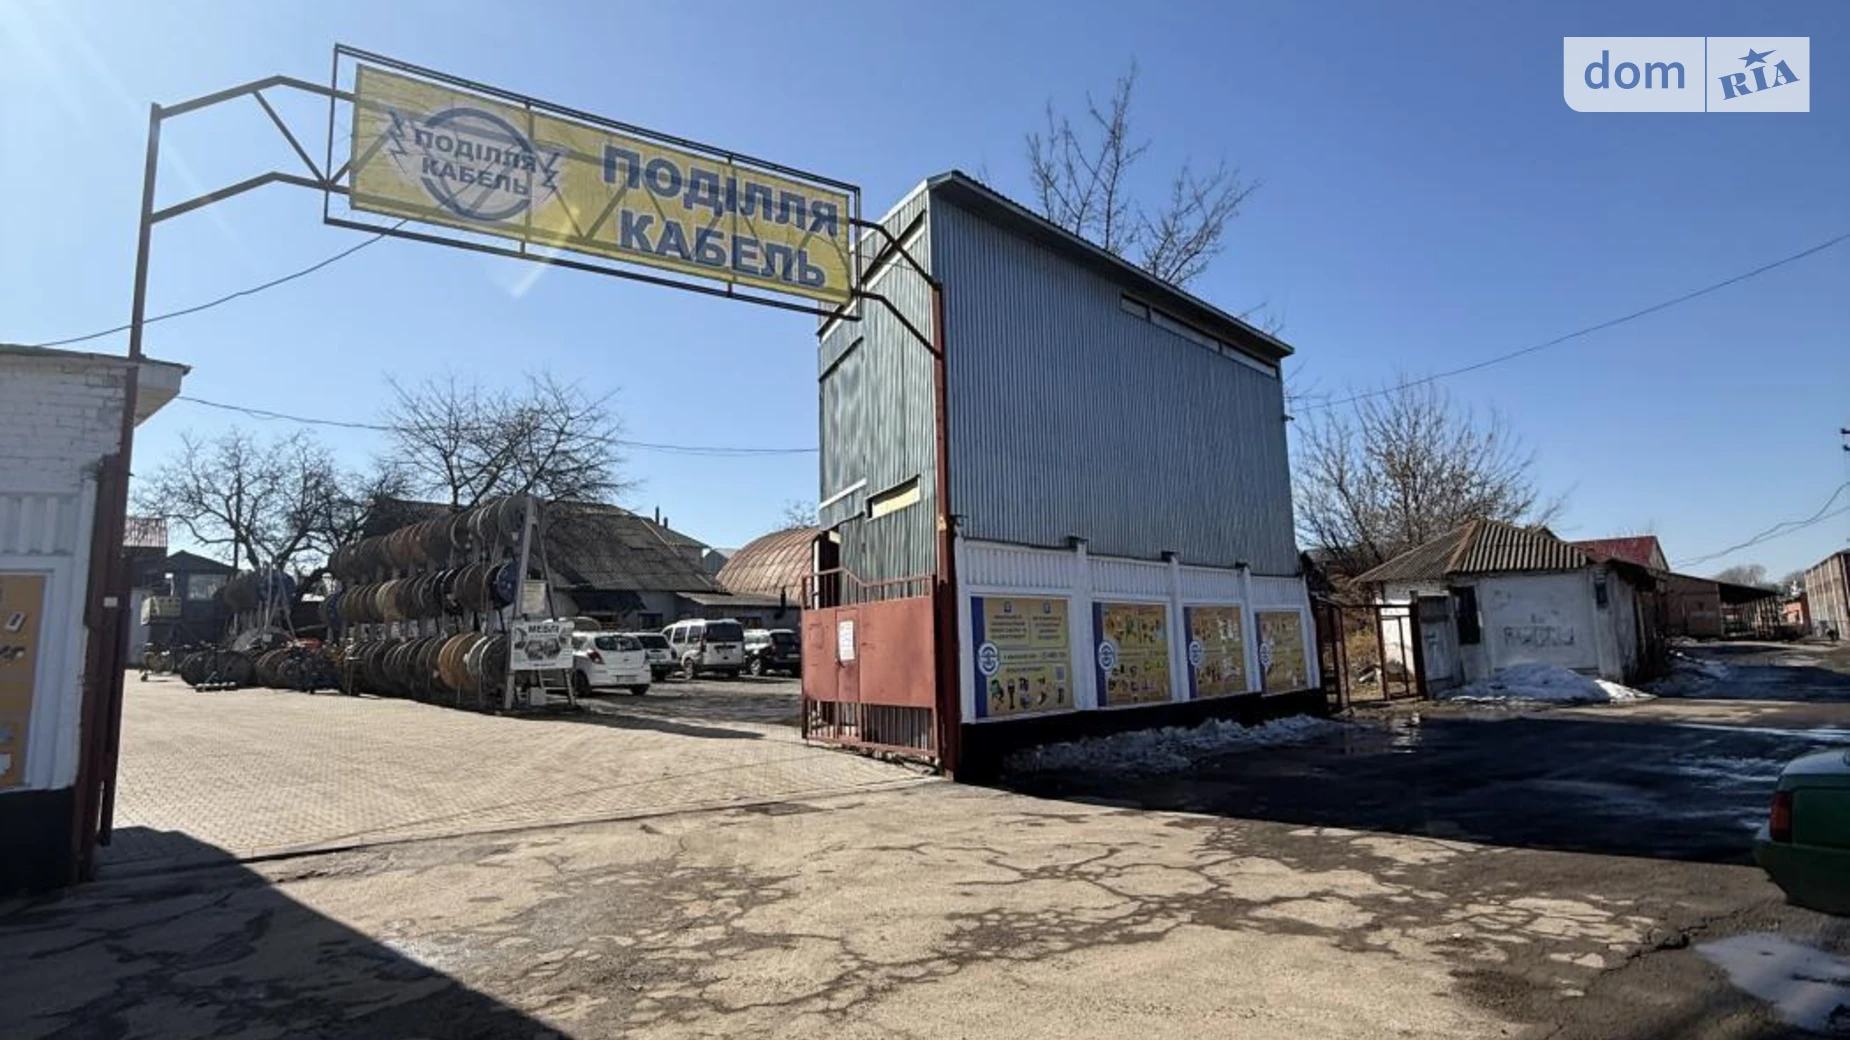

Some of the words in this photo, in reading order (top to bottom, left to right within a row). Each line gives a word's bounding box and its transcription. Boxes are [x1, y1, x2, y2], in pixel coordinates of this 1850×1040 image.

[415, 129, 536, 173] ПОДІЛЛЯ
[422, 157, 530, 195] КАБЕЛЬ
[604, 146, 837, 237] ПОДІЛЛЯ
[620, 210, 826, 287] КАБЕЛЬ
